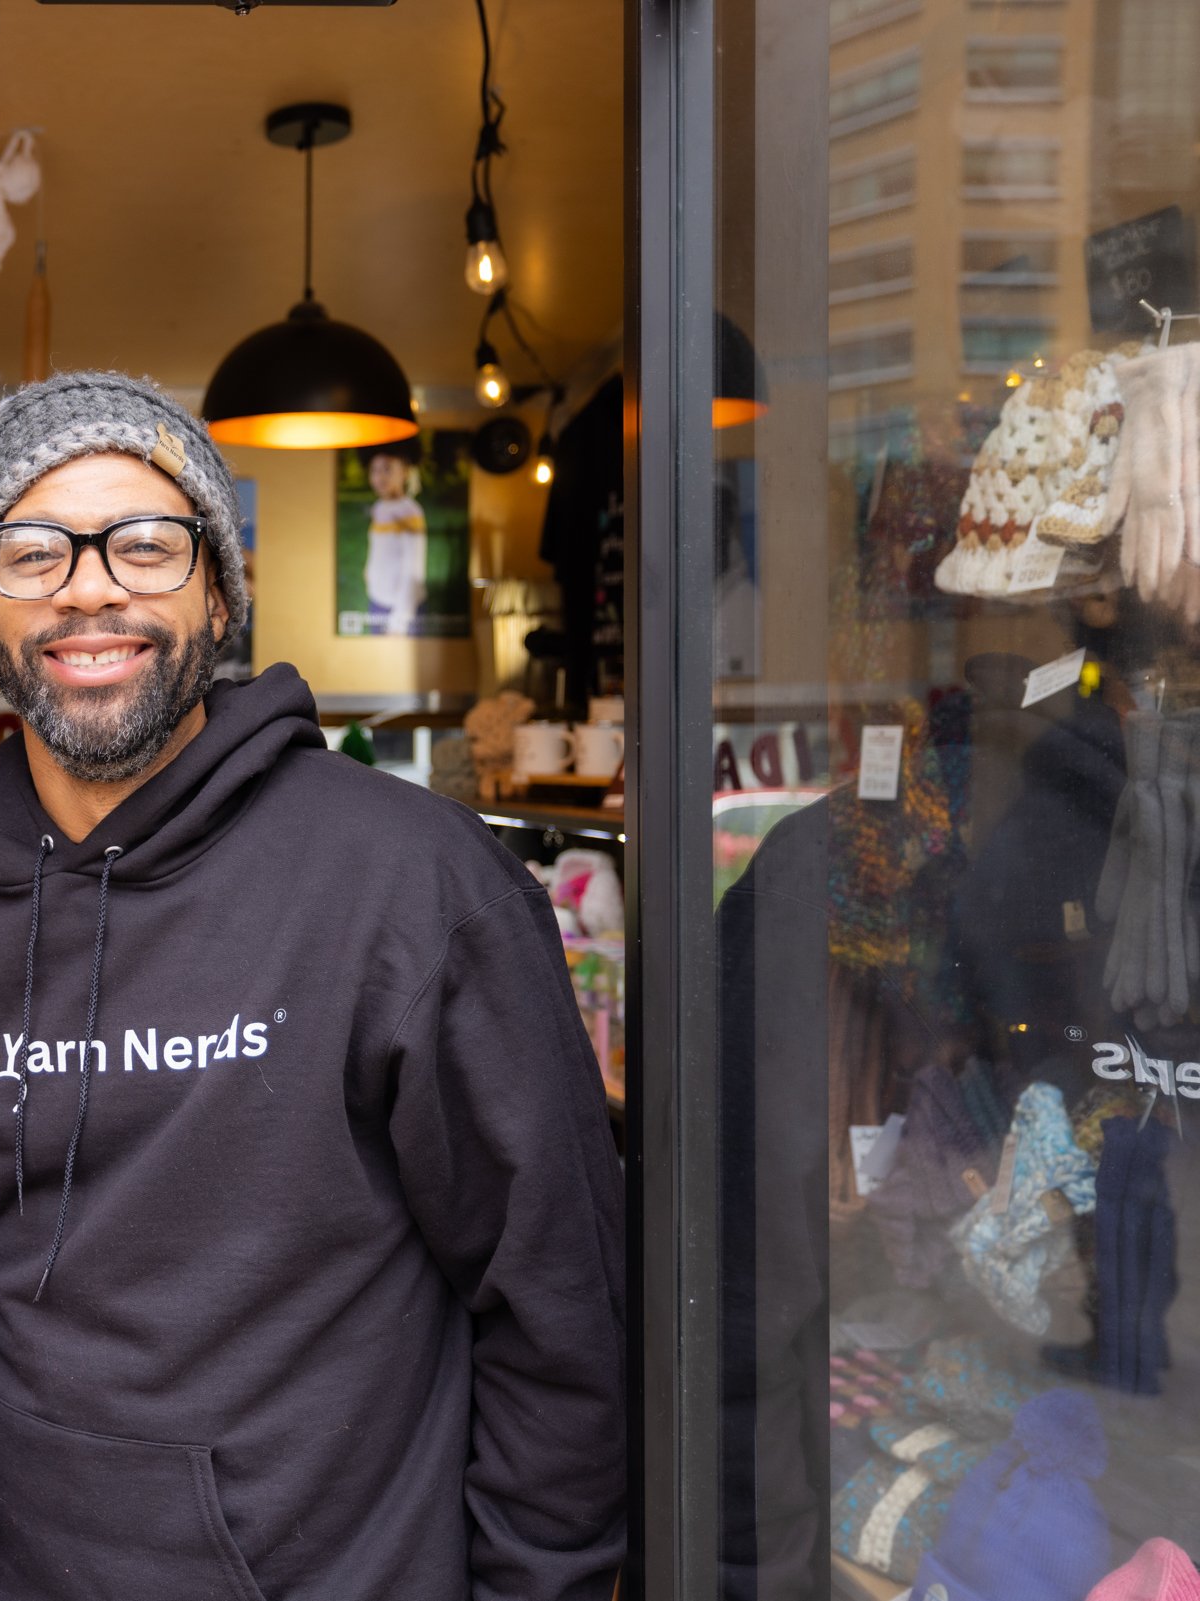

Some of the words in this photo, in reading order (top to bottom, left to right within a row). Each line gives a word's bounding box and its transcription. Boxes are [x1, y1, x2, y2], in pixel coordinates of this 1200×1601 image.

[159, 440, 170, 452] Yarn
[170, 448, 184, 463] Nerds
[3, 1033, 106, 1073] Yarn
